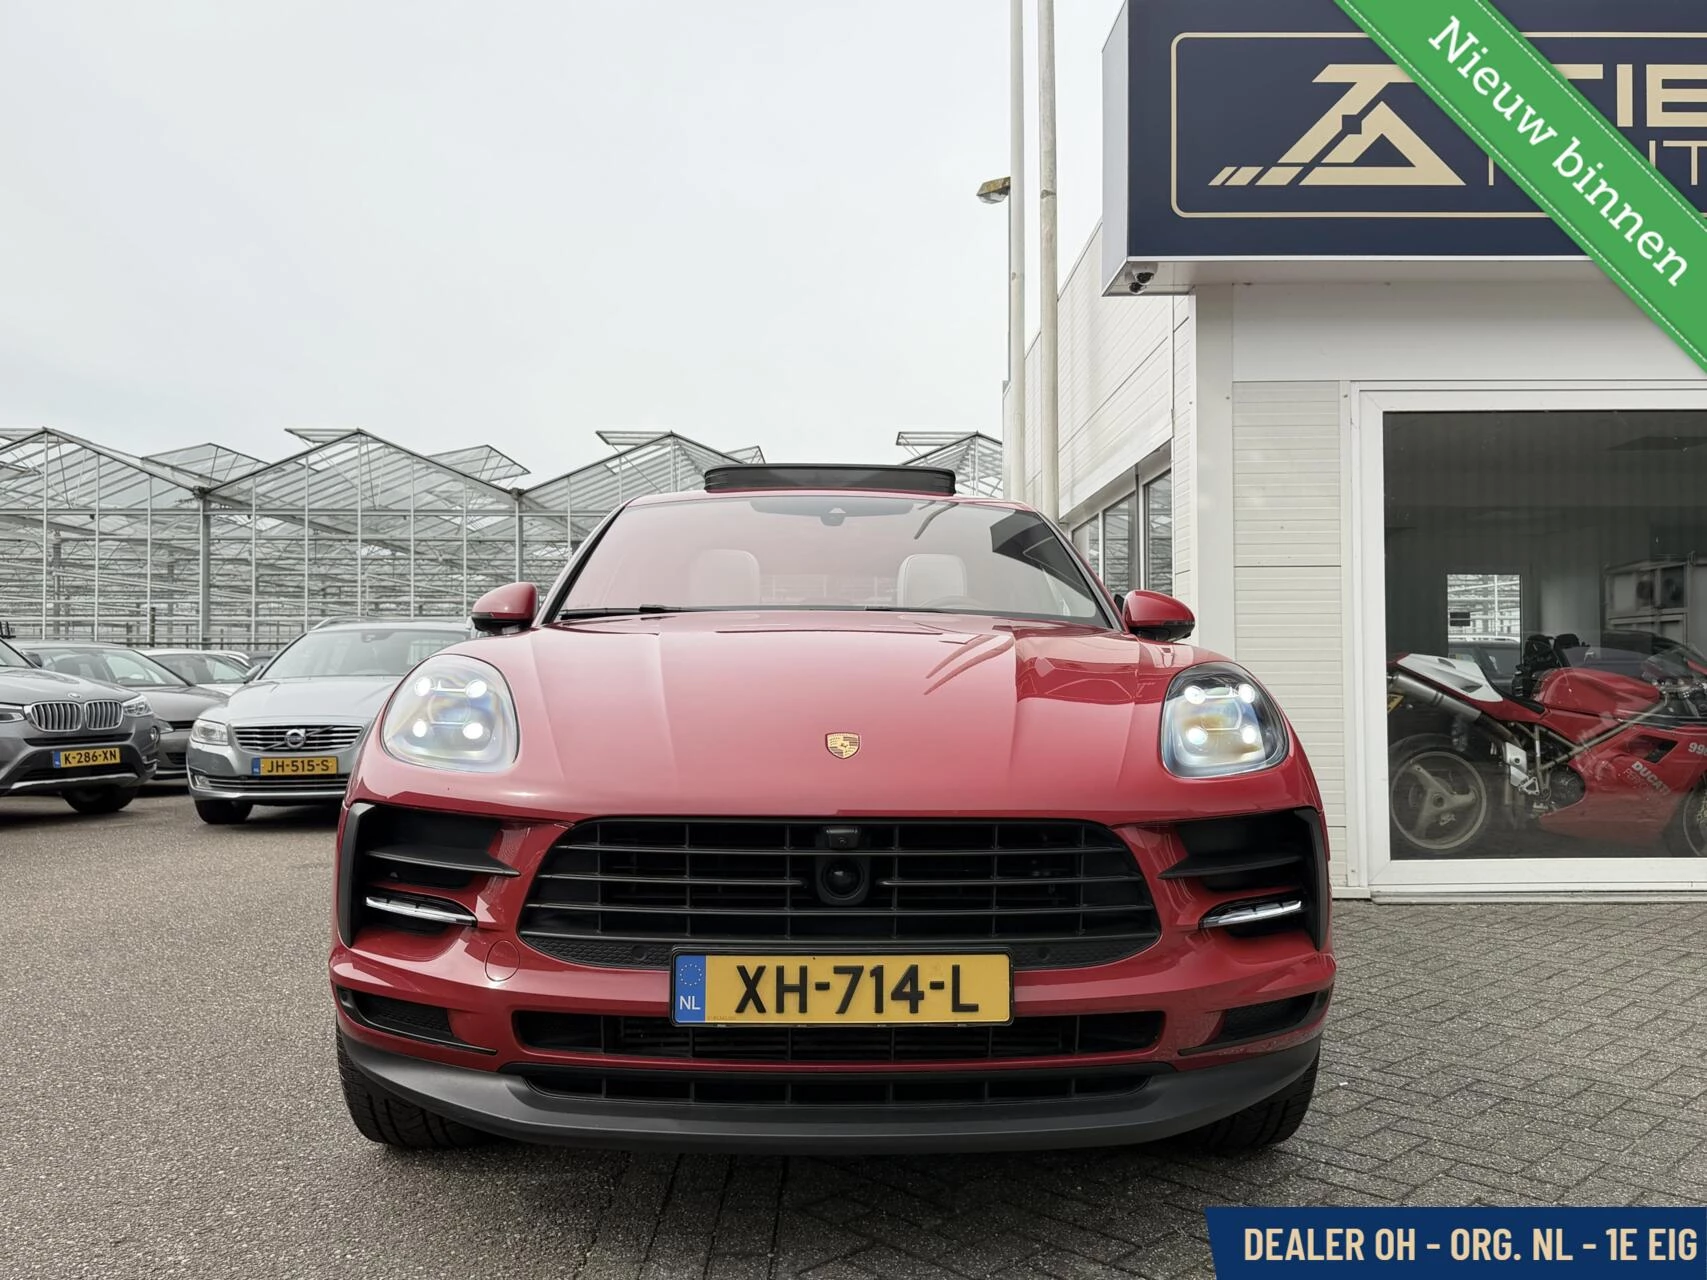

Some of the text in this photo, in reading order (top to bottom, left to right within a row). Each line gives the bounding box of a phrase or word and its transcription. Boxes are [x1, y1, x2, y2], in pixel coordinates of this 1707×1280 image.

[64, 750, 117, 765] K-286-XN
[267, 759, 330, 773] JH-515-S
[1632, 761, 1671, 796] DUCATI
[735, 964, 979, 1014] XH-714-L
[679, 995, 701, 1010] NL
